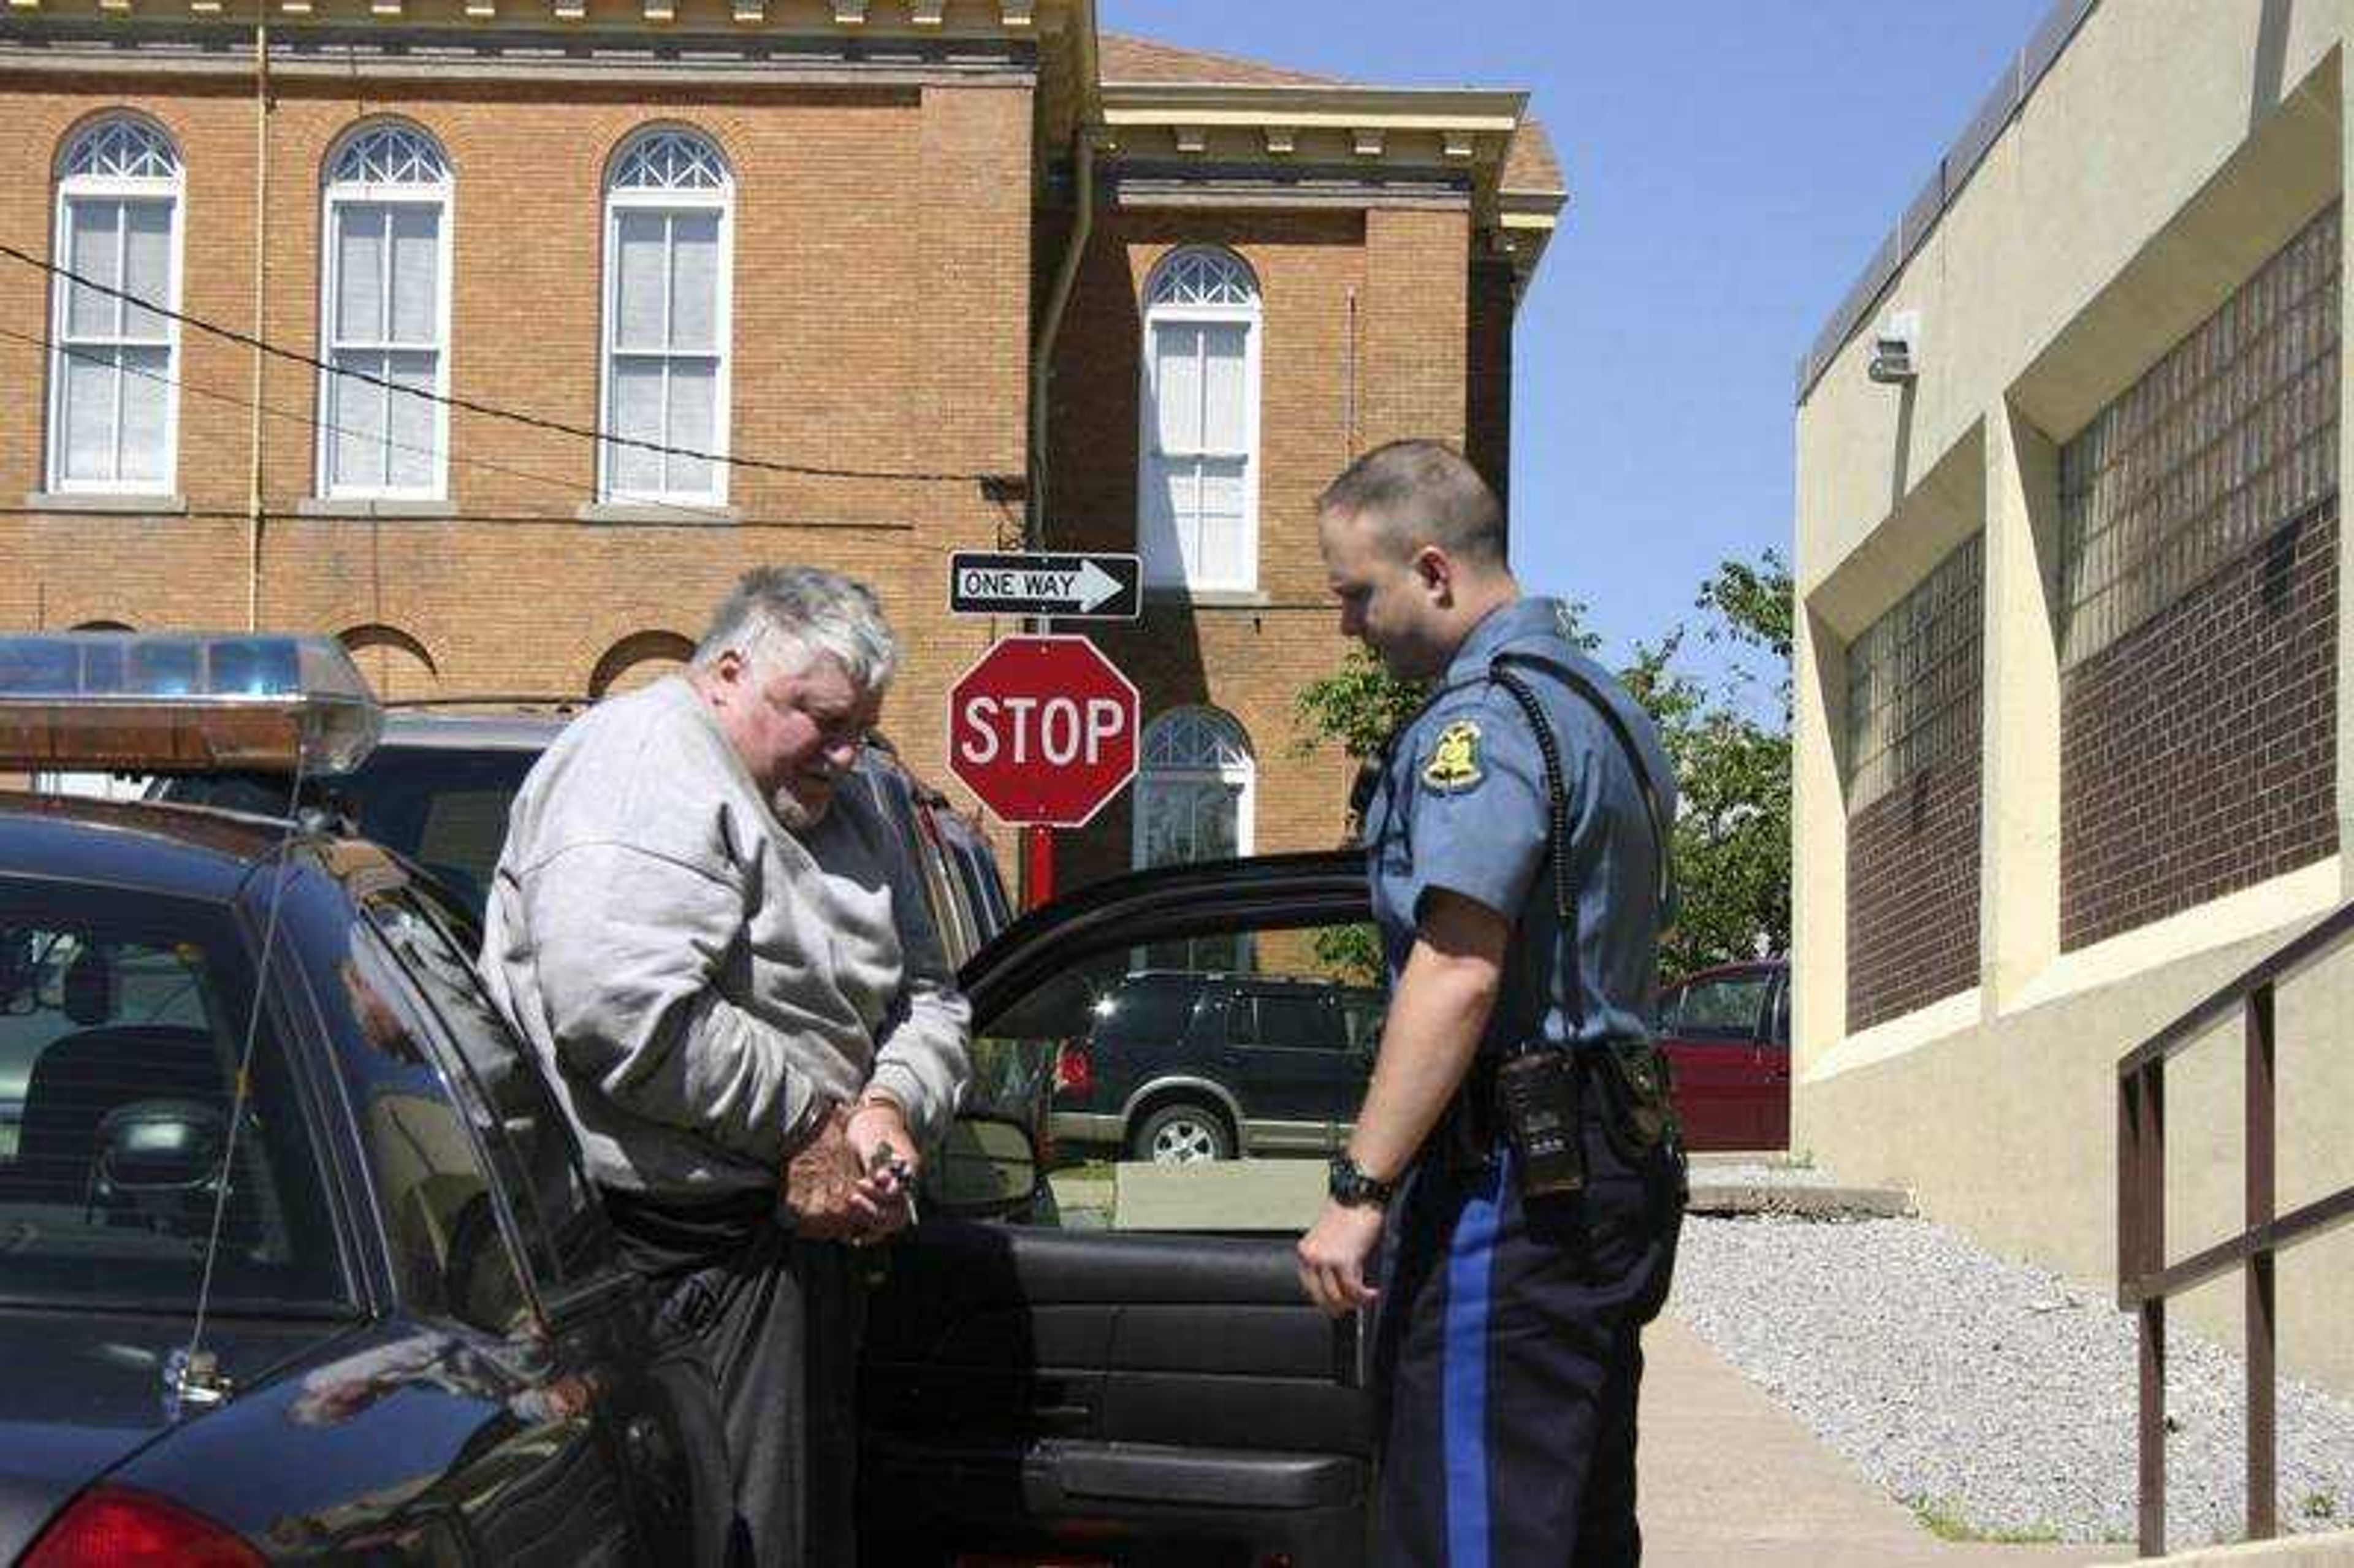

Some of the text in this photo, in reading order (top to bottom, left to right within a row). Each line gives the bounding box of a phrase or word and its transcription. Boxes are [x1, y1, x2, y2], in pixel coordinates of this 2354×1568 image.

[964, 573, 1075, 596] ONE WAY
[961, 697, 1125, 764] STOP
